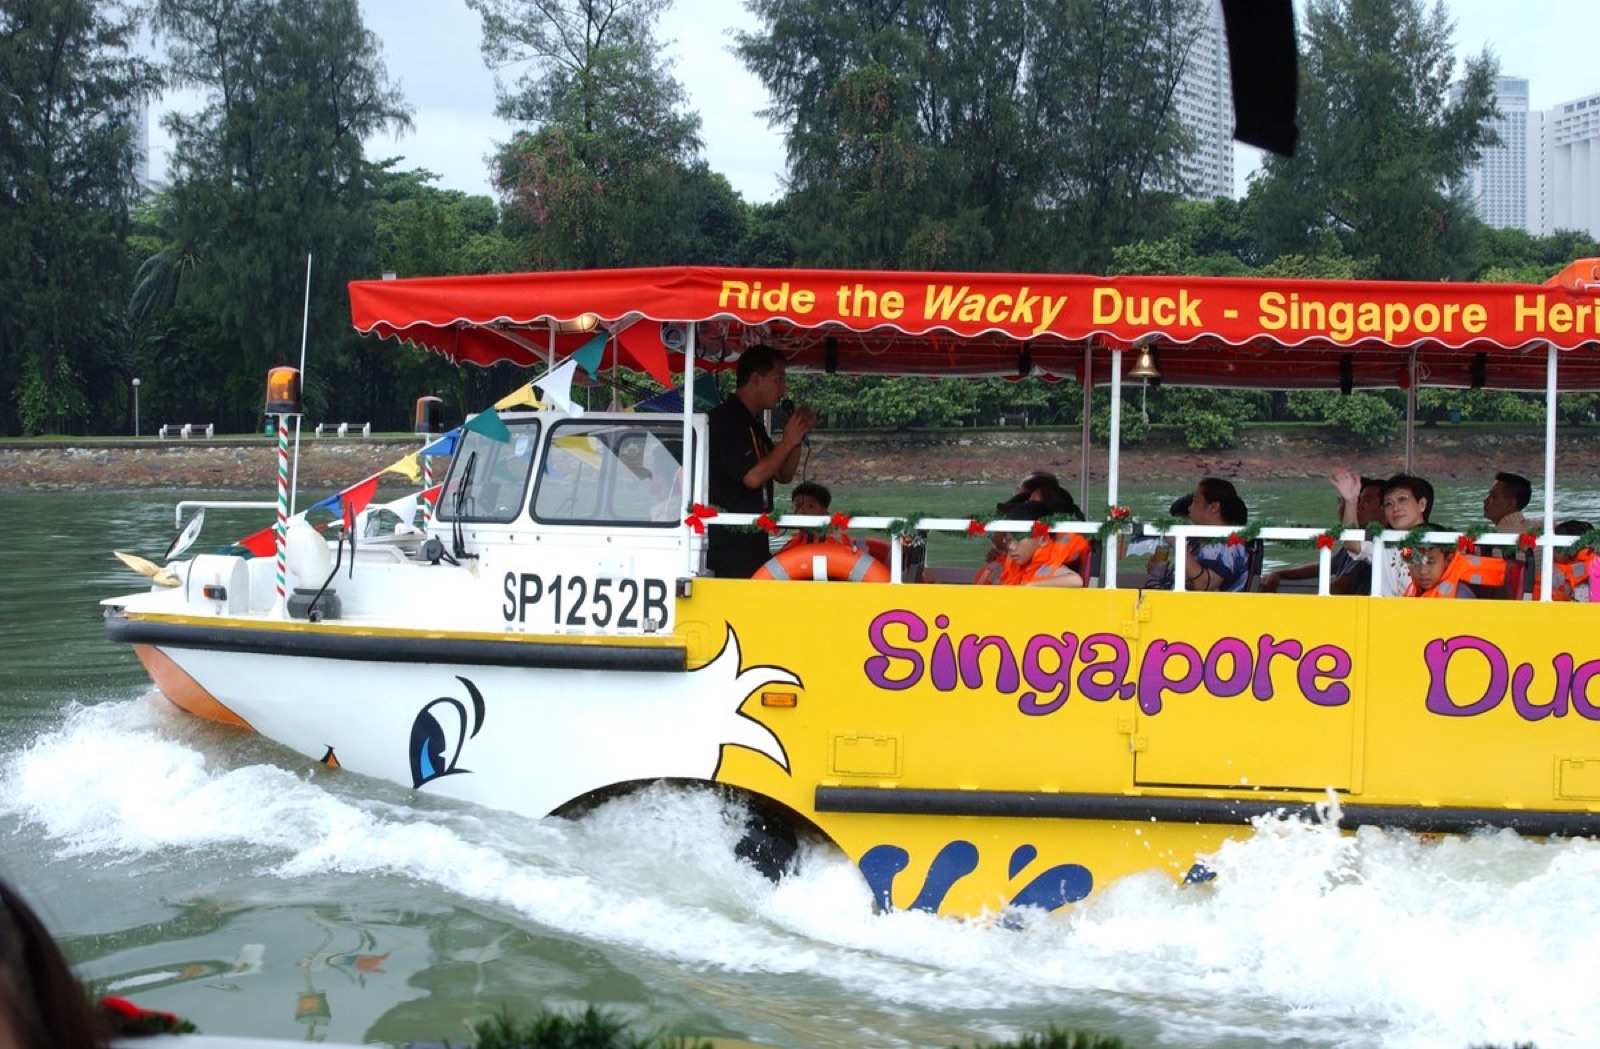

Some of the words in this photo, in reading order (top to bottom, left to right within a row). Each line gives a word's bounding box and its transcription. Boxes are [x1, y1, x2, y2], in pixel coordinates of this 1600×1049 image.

[718, 280, 816, 314] Ride
[836, 284, 905, 320] the
[923, 284, 1067, 335] Wacky
[1092, 287, 1203, 327] Duck
[1258, 291, 1488, 340] Singapore
[502, 571, 669, 630] SP1252B
[864, 609, 1353, 717] Singapore
